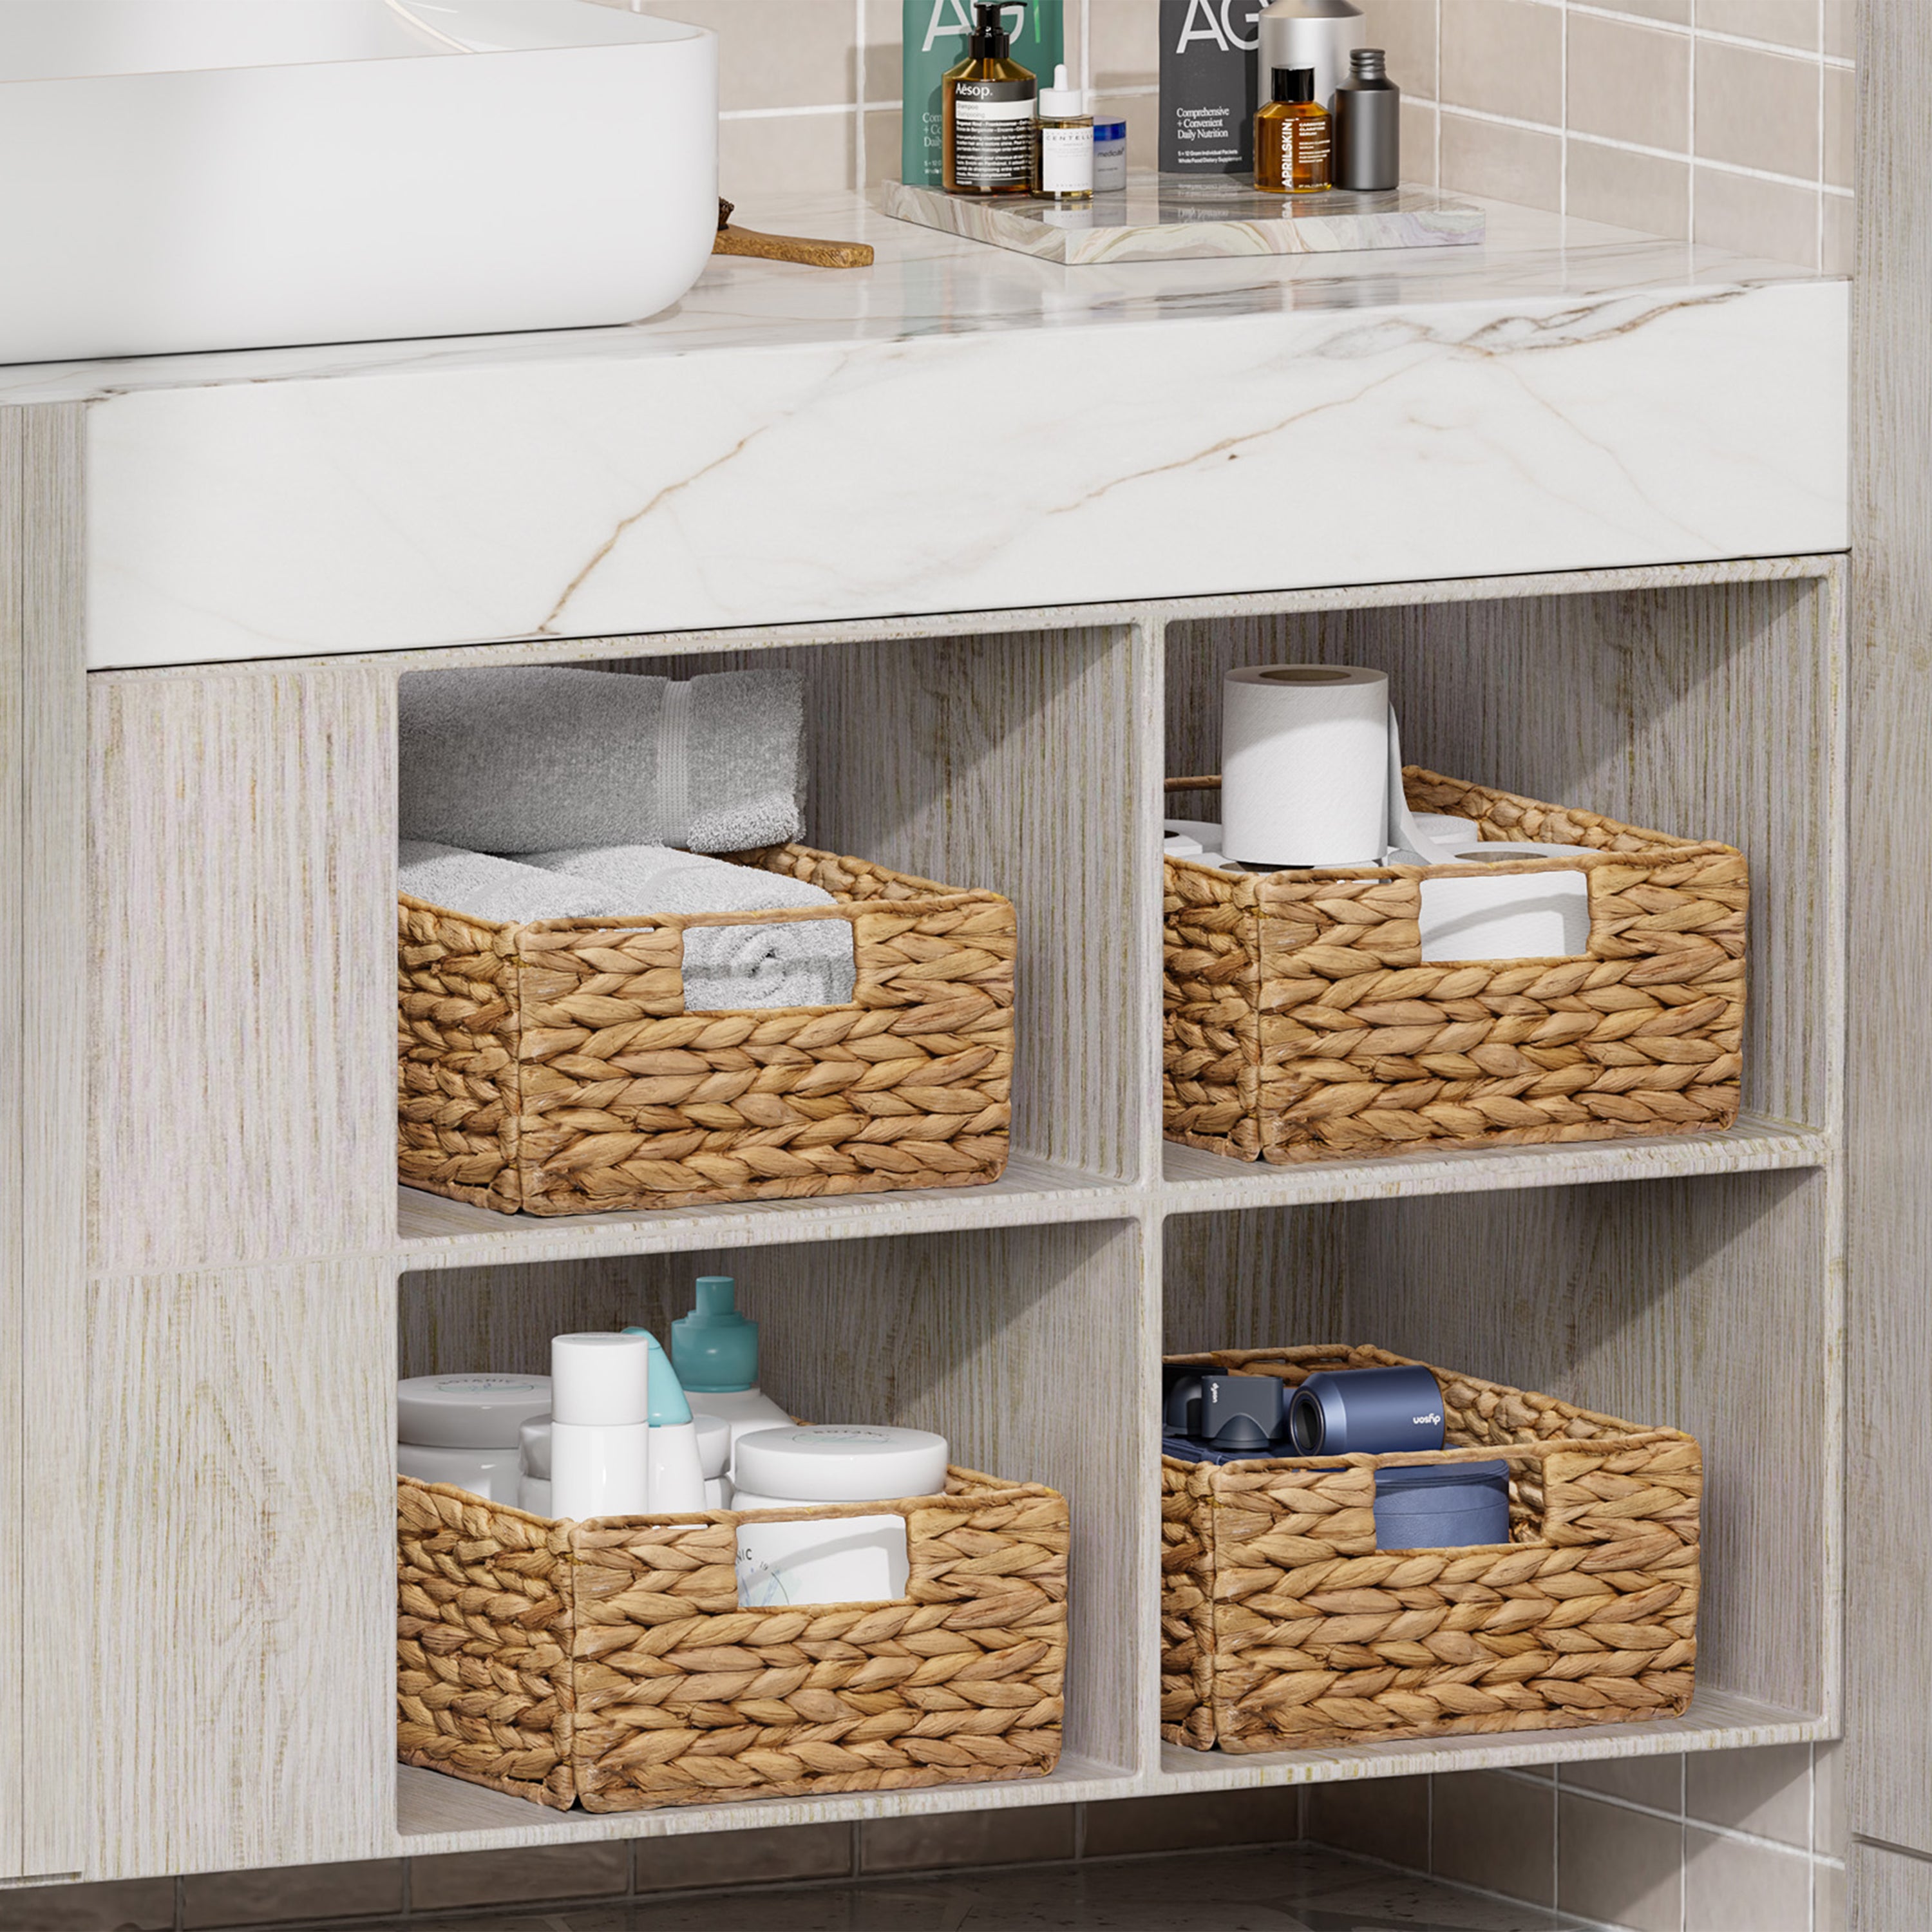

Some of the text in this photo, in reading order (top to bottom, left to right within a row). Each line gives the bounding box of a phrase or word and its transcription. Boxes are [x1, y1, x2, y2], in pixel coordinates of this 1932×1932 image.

[1177, 106, 1229, 119] Comprehensive
[1183, 118, 1223, 128] Convenient
[1177, 128, 1228, 141] Daily Nutrition
[1282, 122, 1293, 188] APRILSKIN
[1413, 1413, 1441, 1425] dyson
